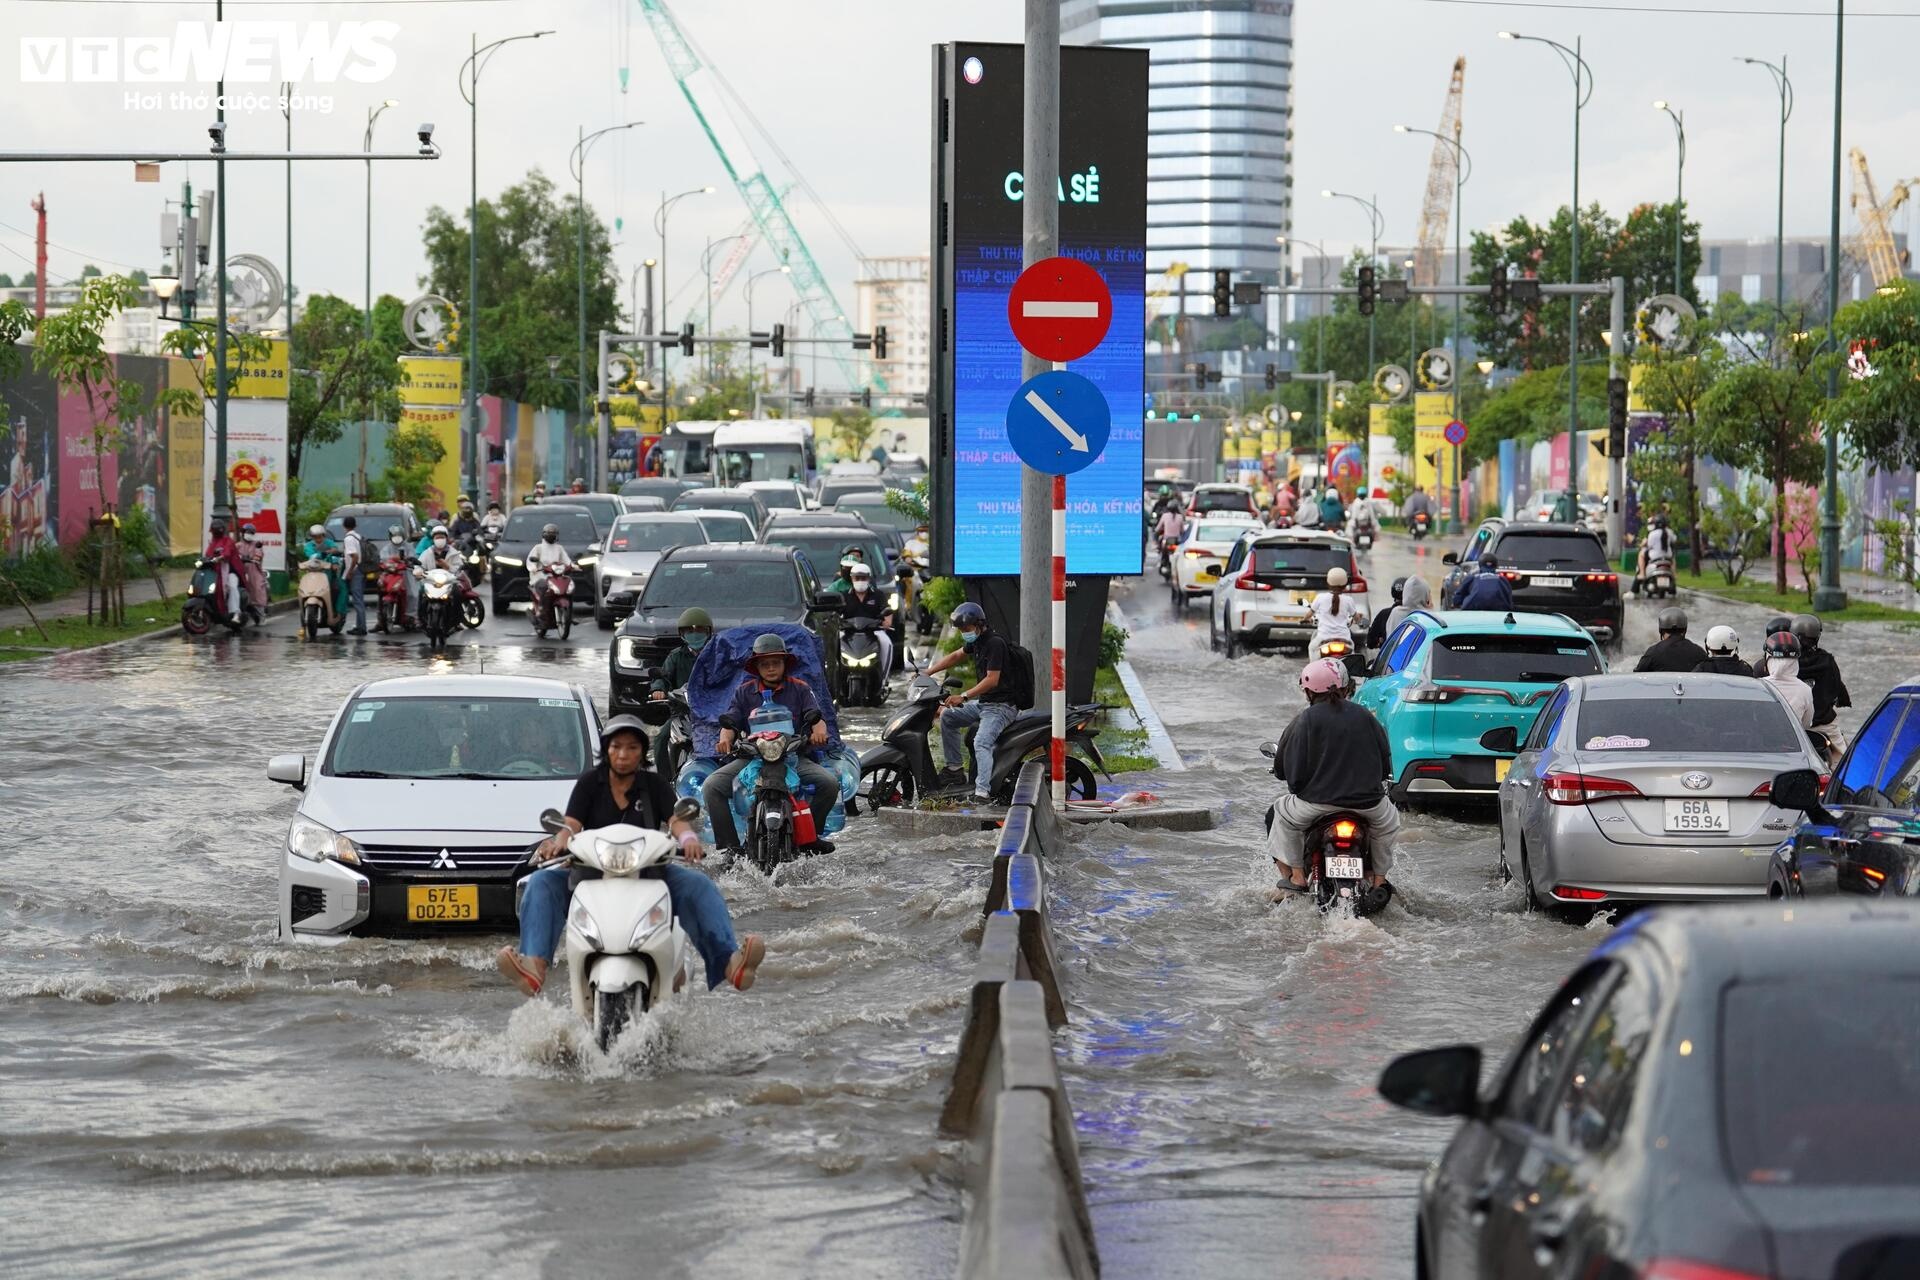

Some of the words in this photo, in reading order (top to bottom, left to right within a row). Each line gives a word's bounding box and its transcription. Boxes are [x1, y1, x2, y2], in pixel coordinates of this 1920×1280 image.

[1070, 165, 1100, 202] SẺ
[979, 246, 1000, 259] THU
[960, 266, 990, 287] THẬP
[977, 501, 999, 514] THU
[1683, 801, 1711, 814] 66A
[1673, 816, 1722, 829] 159.94
[1331, 857, 1358, 868] 50-AD
[427, 887, 458, 902] 67E
[416, 904, 471, 919] 002.33
